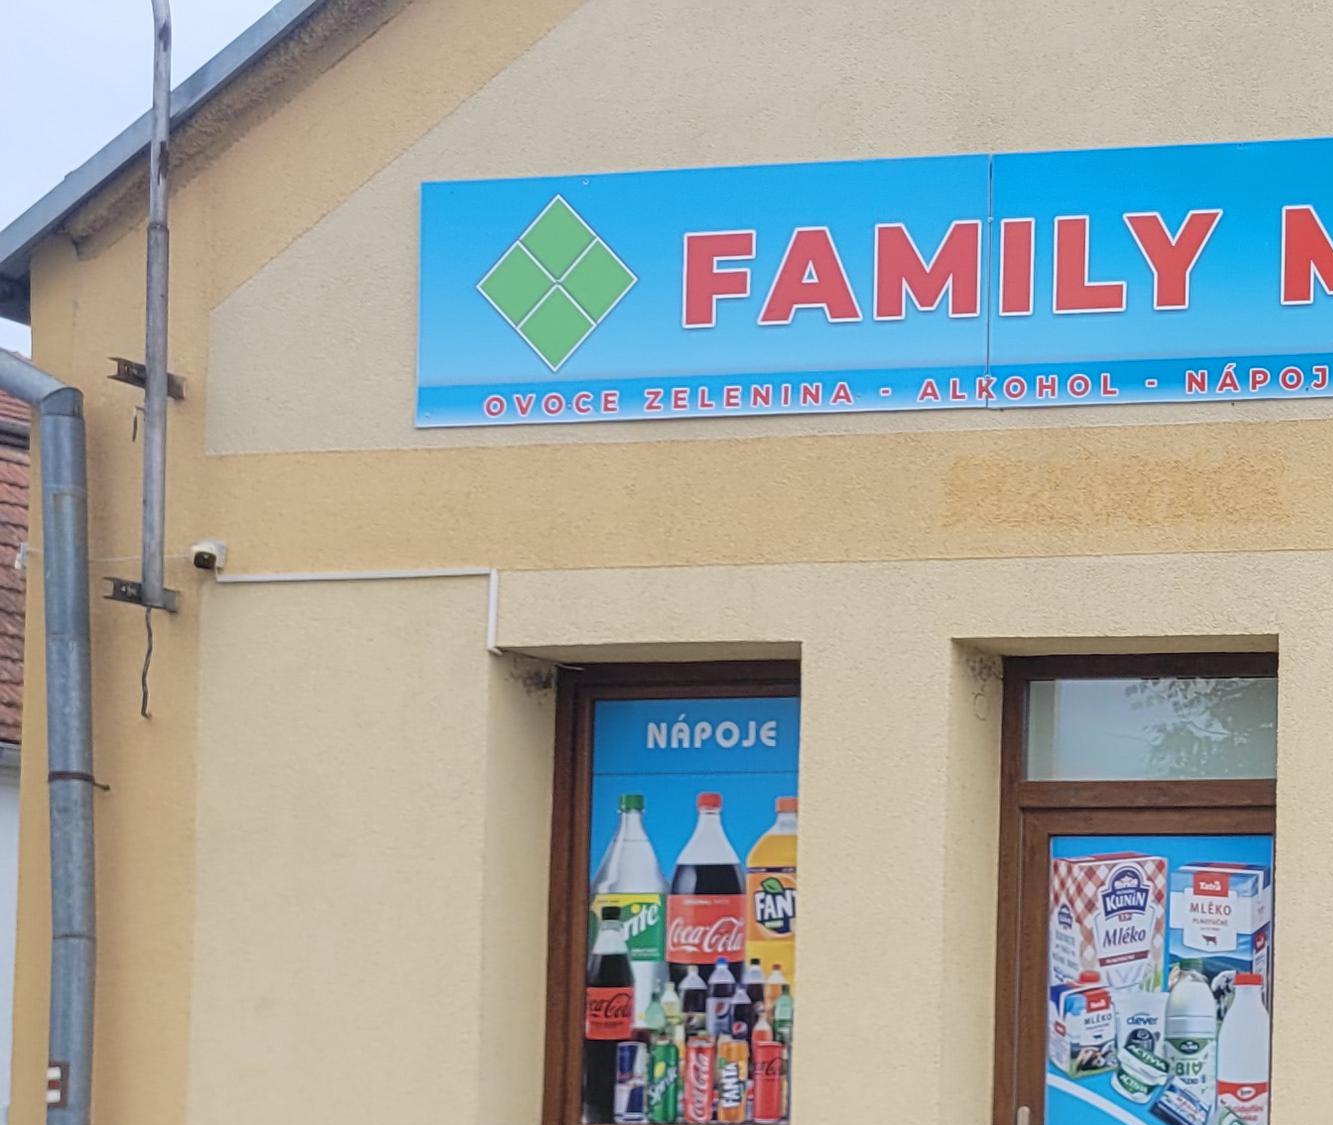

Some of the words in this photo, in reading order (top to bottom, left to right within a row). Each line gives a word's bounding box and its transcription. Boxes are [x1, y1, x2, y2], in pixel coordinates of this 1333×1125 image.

[681, 209, 1224, 331] FAMILY
[482, 390, 621, 419] OVOCE
[643, 379, 853, 413] ZELENINA
[918, 371, 1120, 403] ALKOHOL
[646, 713, 777, 749] NÁPOJE
[1103, 925, 1147, 948] Mléko
